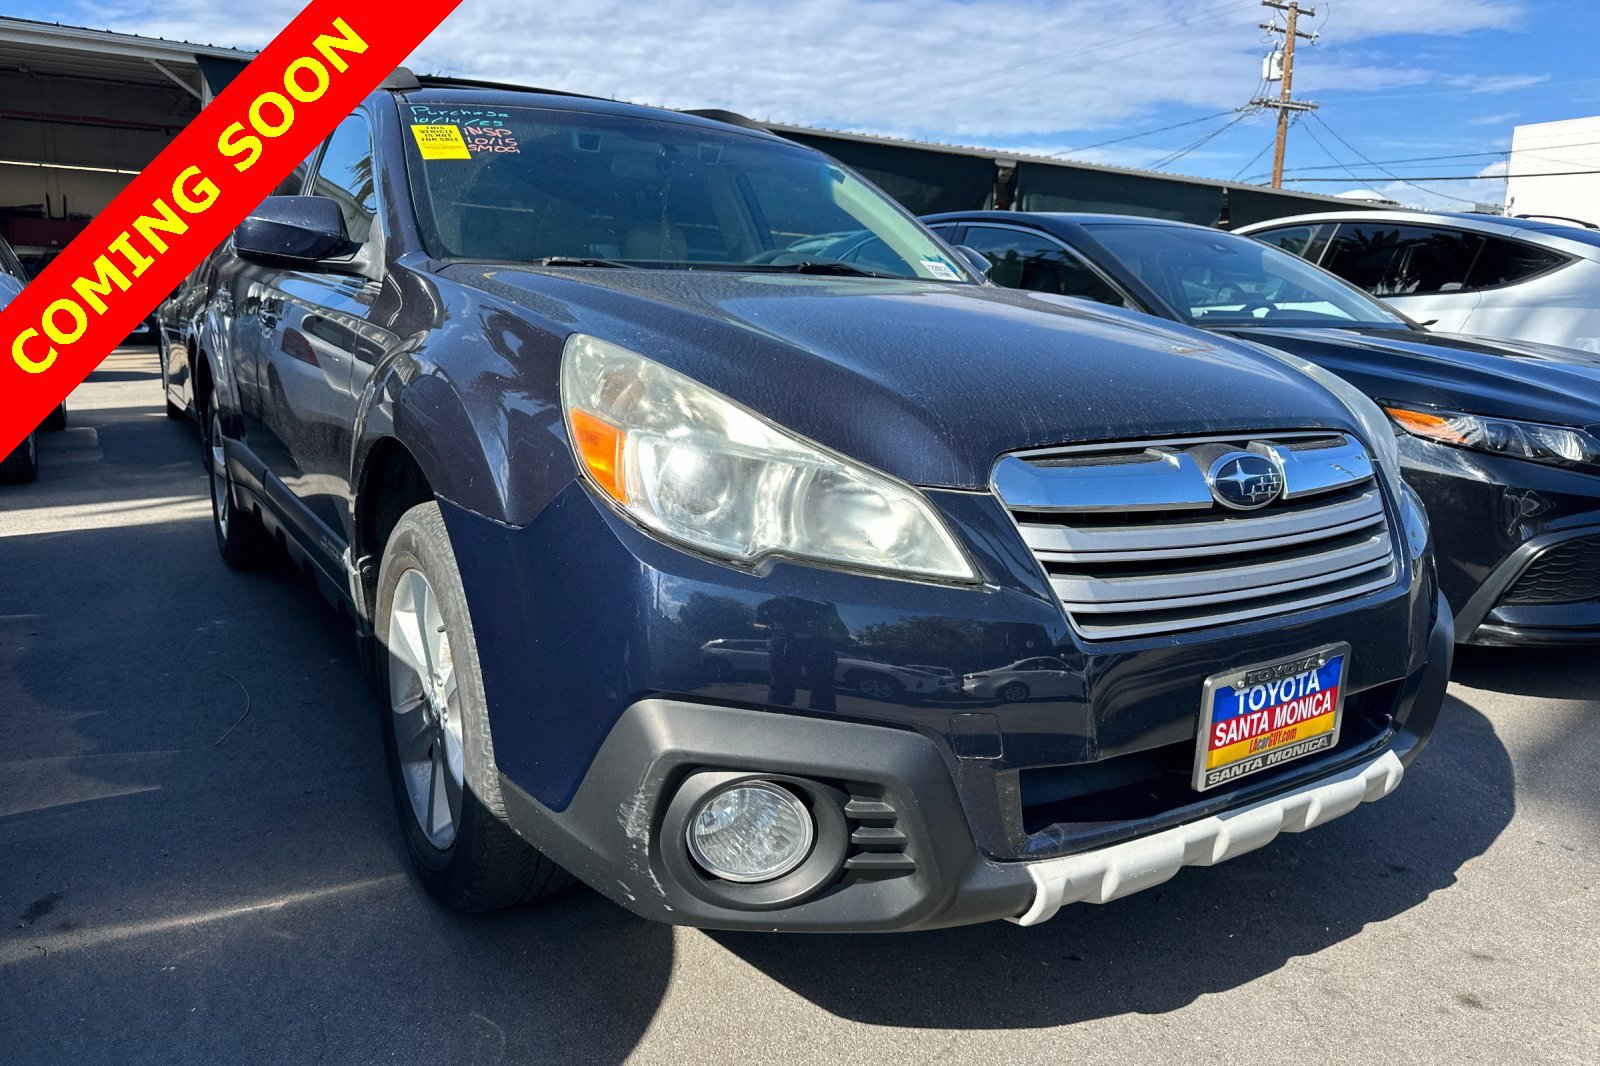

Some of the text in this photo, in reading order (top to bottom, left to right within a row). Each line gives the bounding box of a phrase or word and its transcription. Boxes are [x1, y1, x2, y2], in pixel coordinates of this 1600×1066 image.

[462, 126, 513, 138] INSP
[466, 136, 518, 147] 10/15
[468, 144, 521, 154] SMOG
[1247, 657, 1318, 685] TOYOTA
[1235, 669, 1320, 715] TOYOTA
[1214, 690, 1332, 747] SANTA MONICA
[1208, 736, 1329, 785] SANTA MONICA
